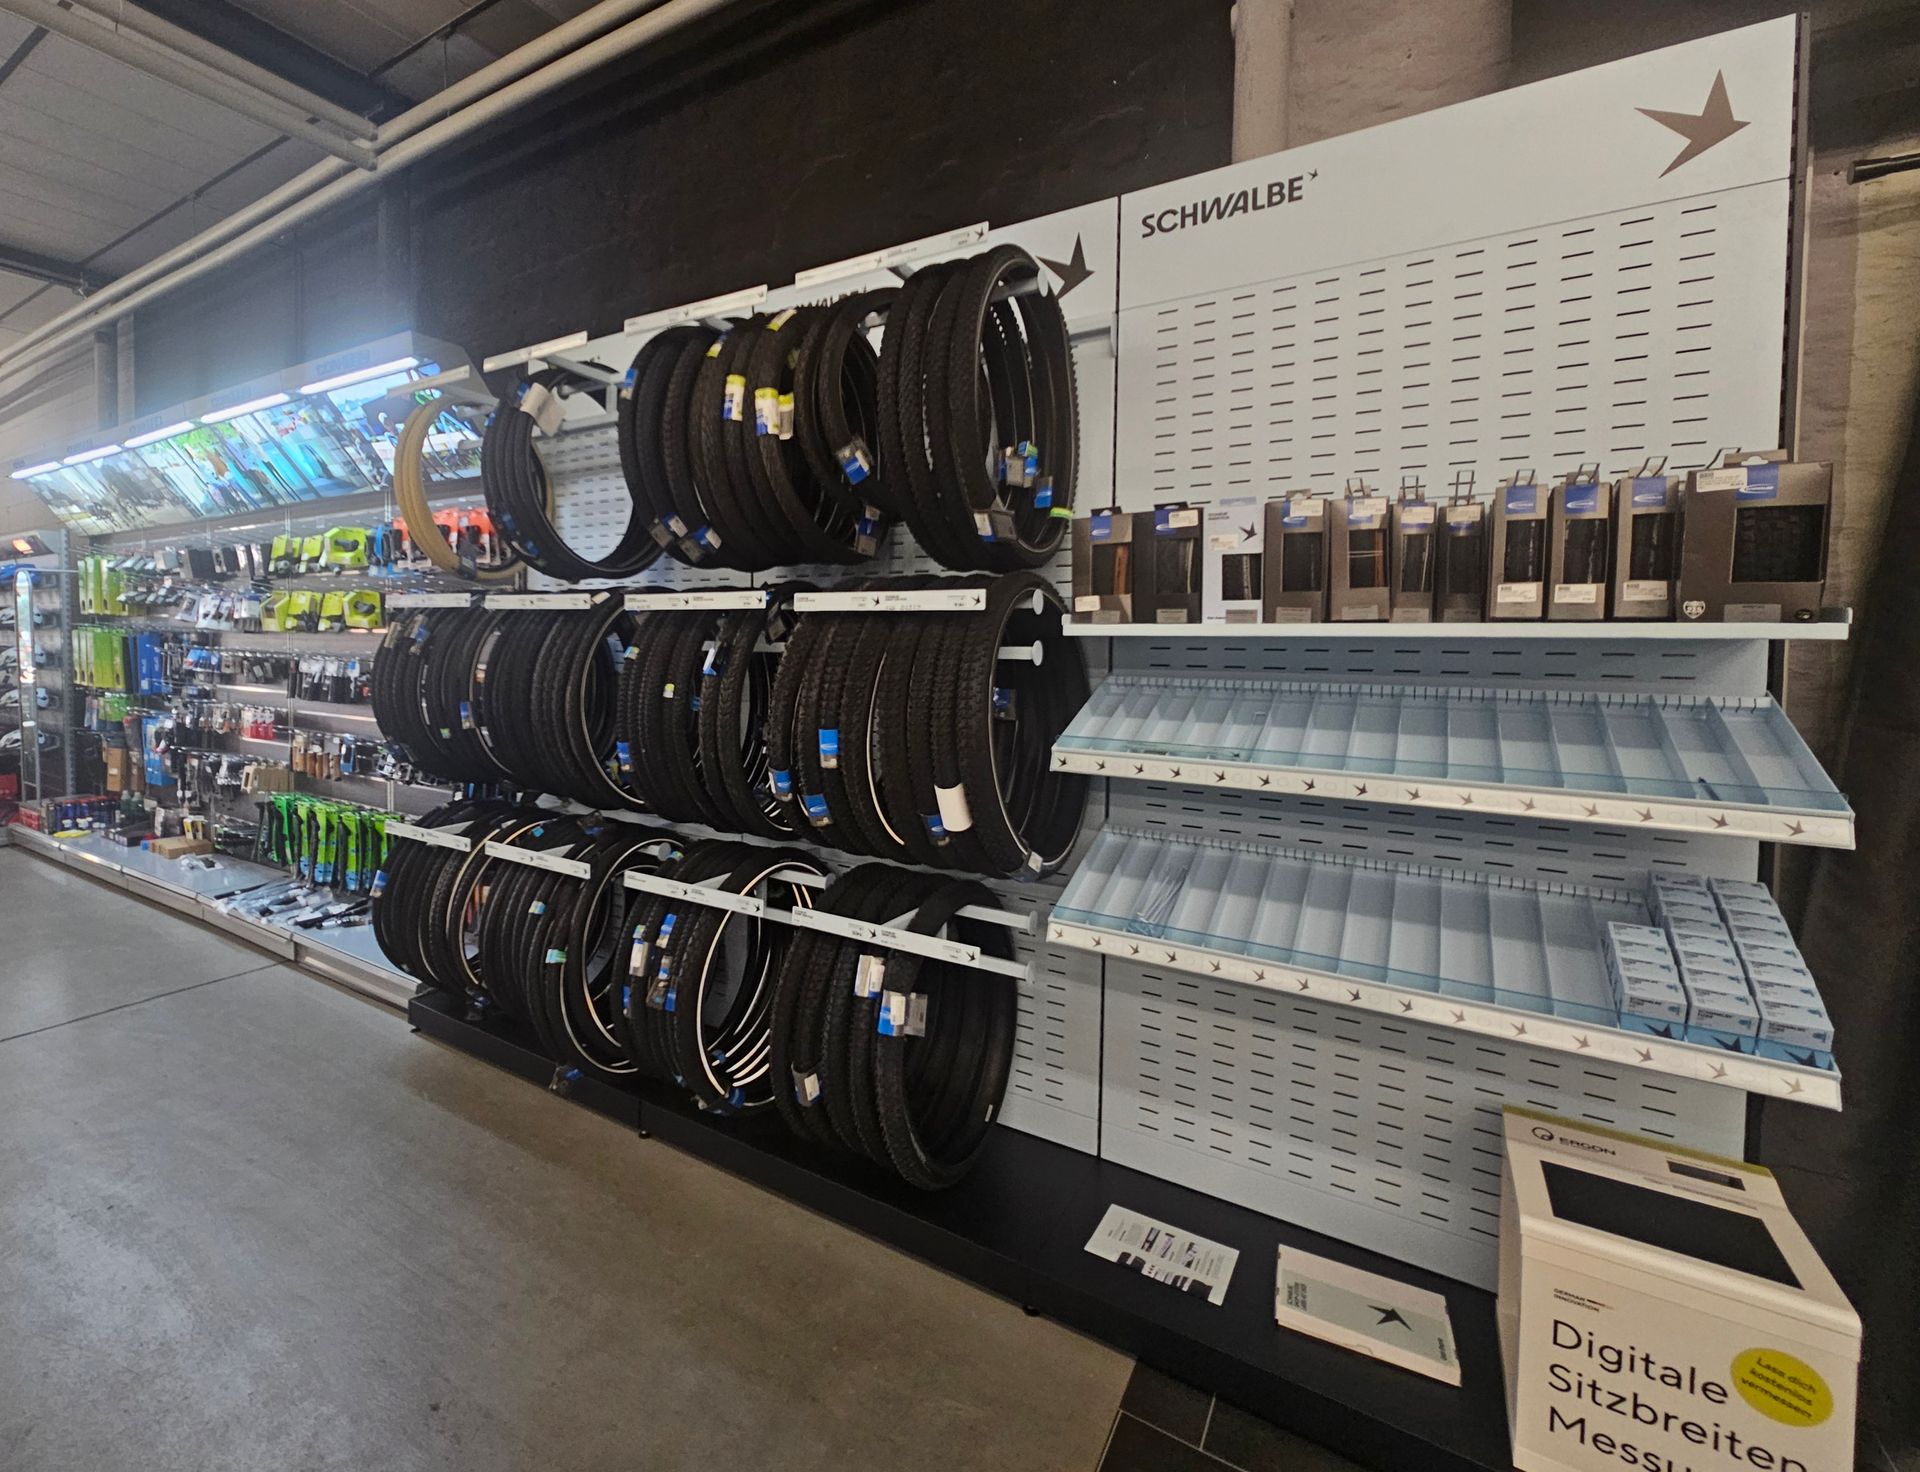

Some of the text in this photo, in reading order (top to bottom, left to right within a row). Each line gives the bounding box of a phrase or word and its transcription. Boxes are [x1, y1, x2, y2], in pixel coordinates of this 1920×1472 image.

[1141, 175, 1304, 239] SCHWALBE
[1559, 1137, 1617, 1156] ERGON
[1552, 1319, 1729, 1404] Digitale
[1787, 1375, 1817, 1395] dich
